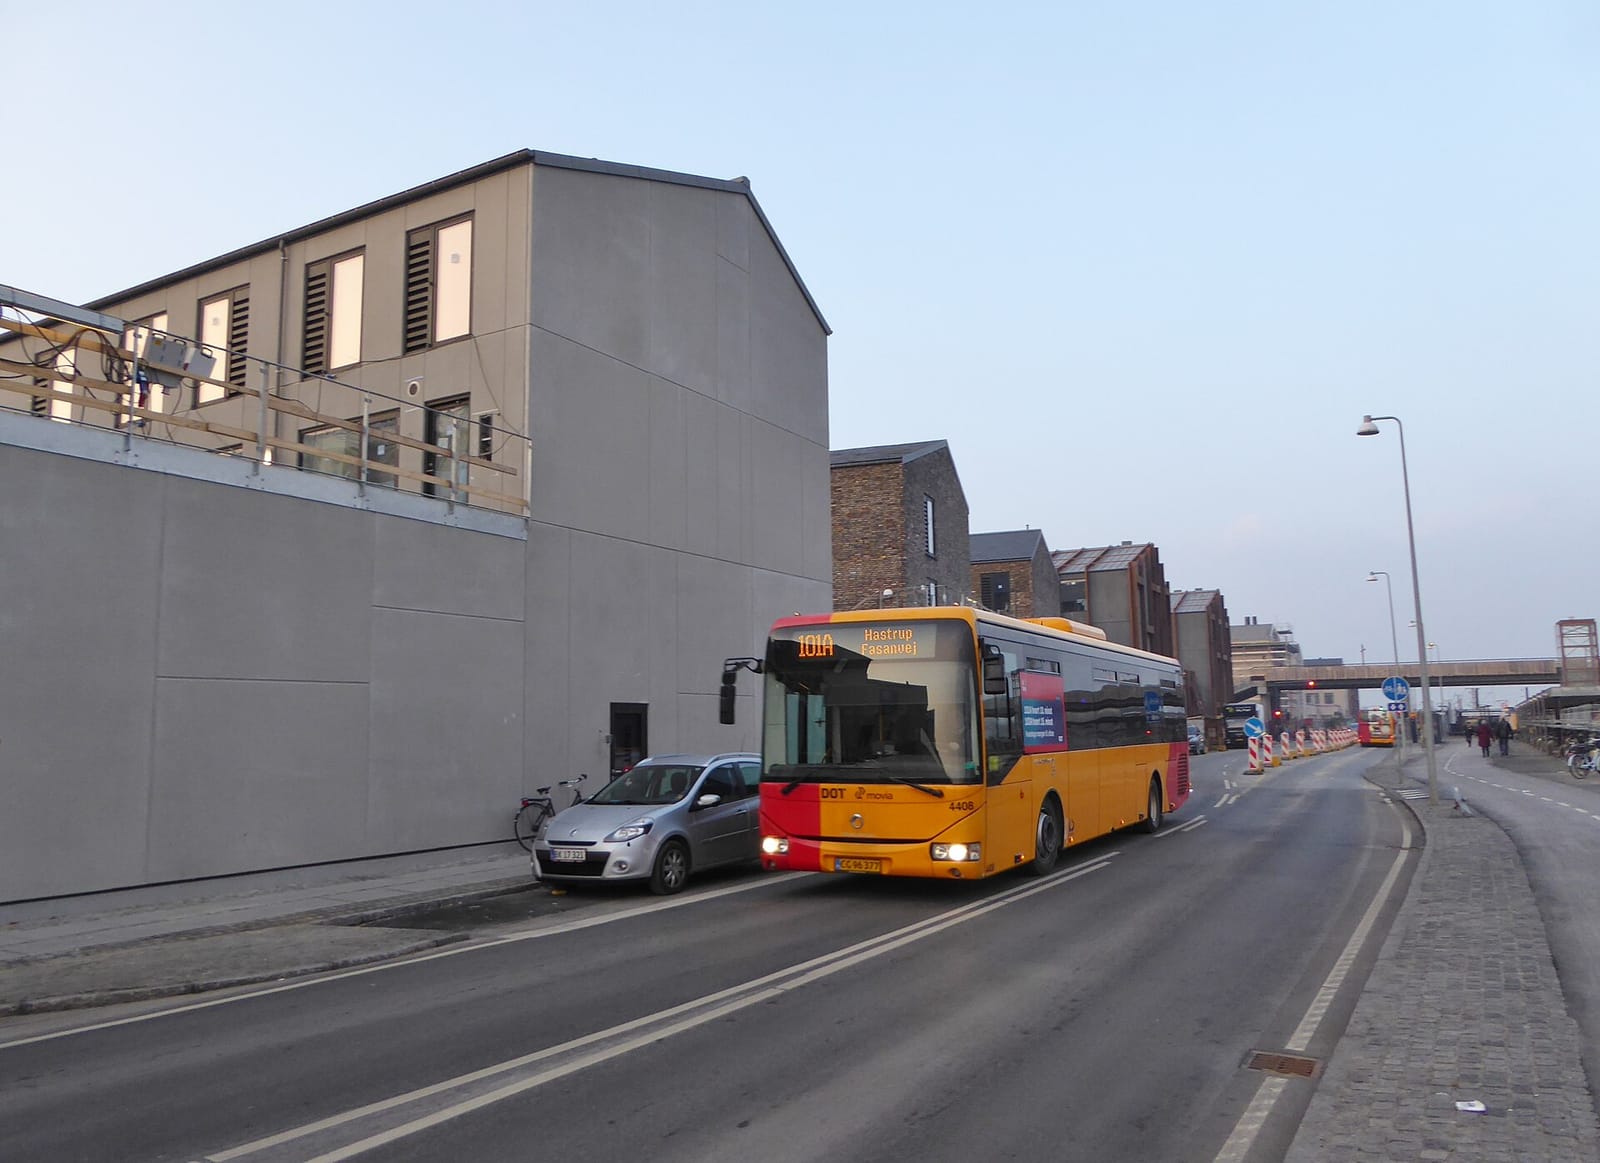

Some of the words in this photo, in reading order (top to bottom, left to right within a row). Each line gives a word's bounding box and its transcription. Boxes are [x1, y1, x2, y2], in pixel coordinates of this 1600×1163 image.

[864, 628, 913, 641] Hastrup
[798, 634, 834, 657] 101A
[821, 788, 846, 799] DOT
[866, 792, 893, 800] movia
